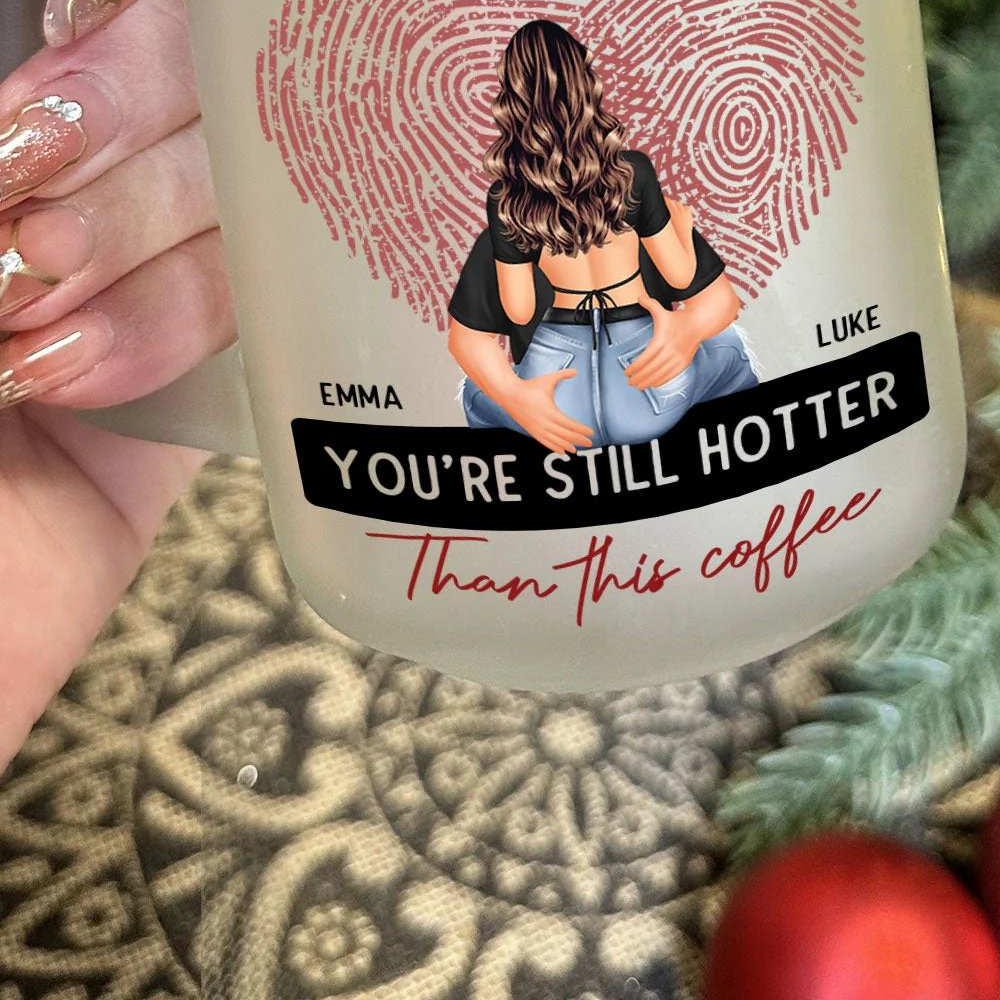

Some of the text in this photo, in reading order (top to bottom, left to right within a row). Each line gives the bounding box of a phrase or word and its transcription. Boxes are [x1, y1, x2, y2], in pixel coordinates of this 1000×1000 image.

[815, 304, 881, 348] LUKE
[319, 382, 403, 410] EMMA
[543, 438, 680, 498] STILL
[701, 370, 899, 475] HOTTER
[366, 487, 882, 627] Than this coffee
